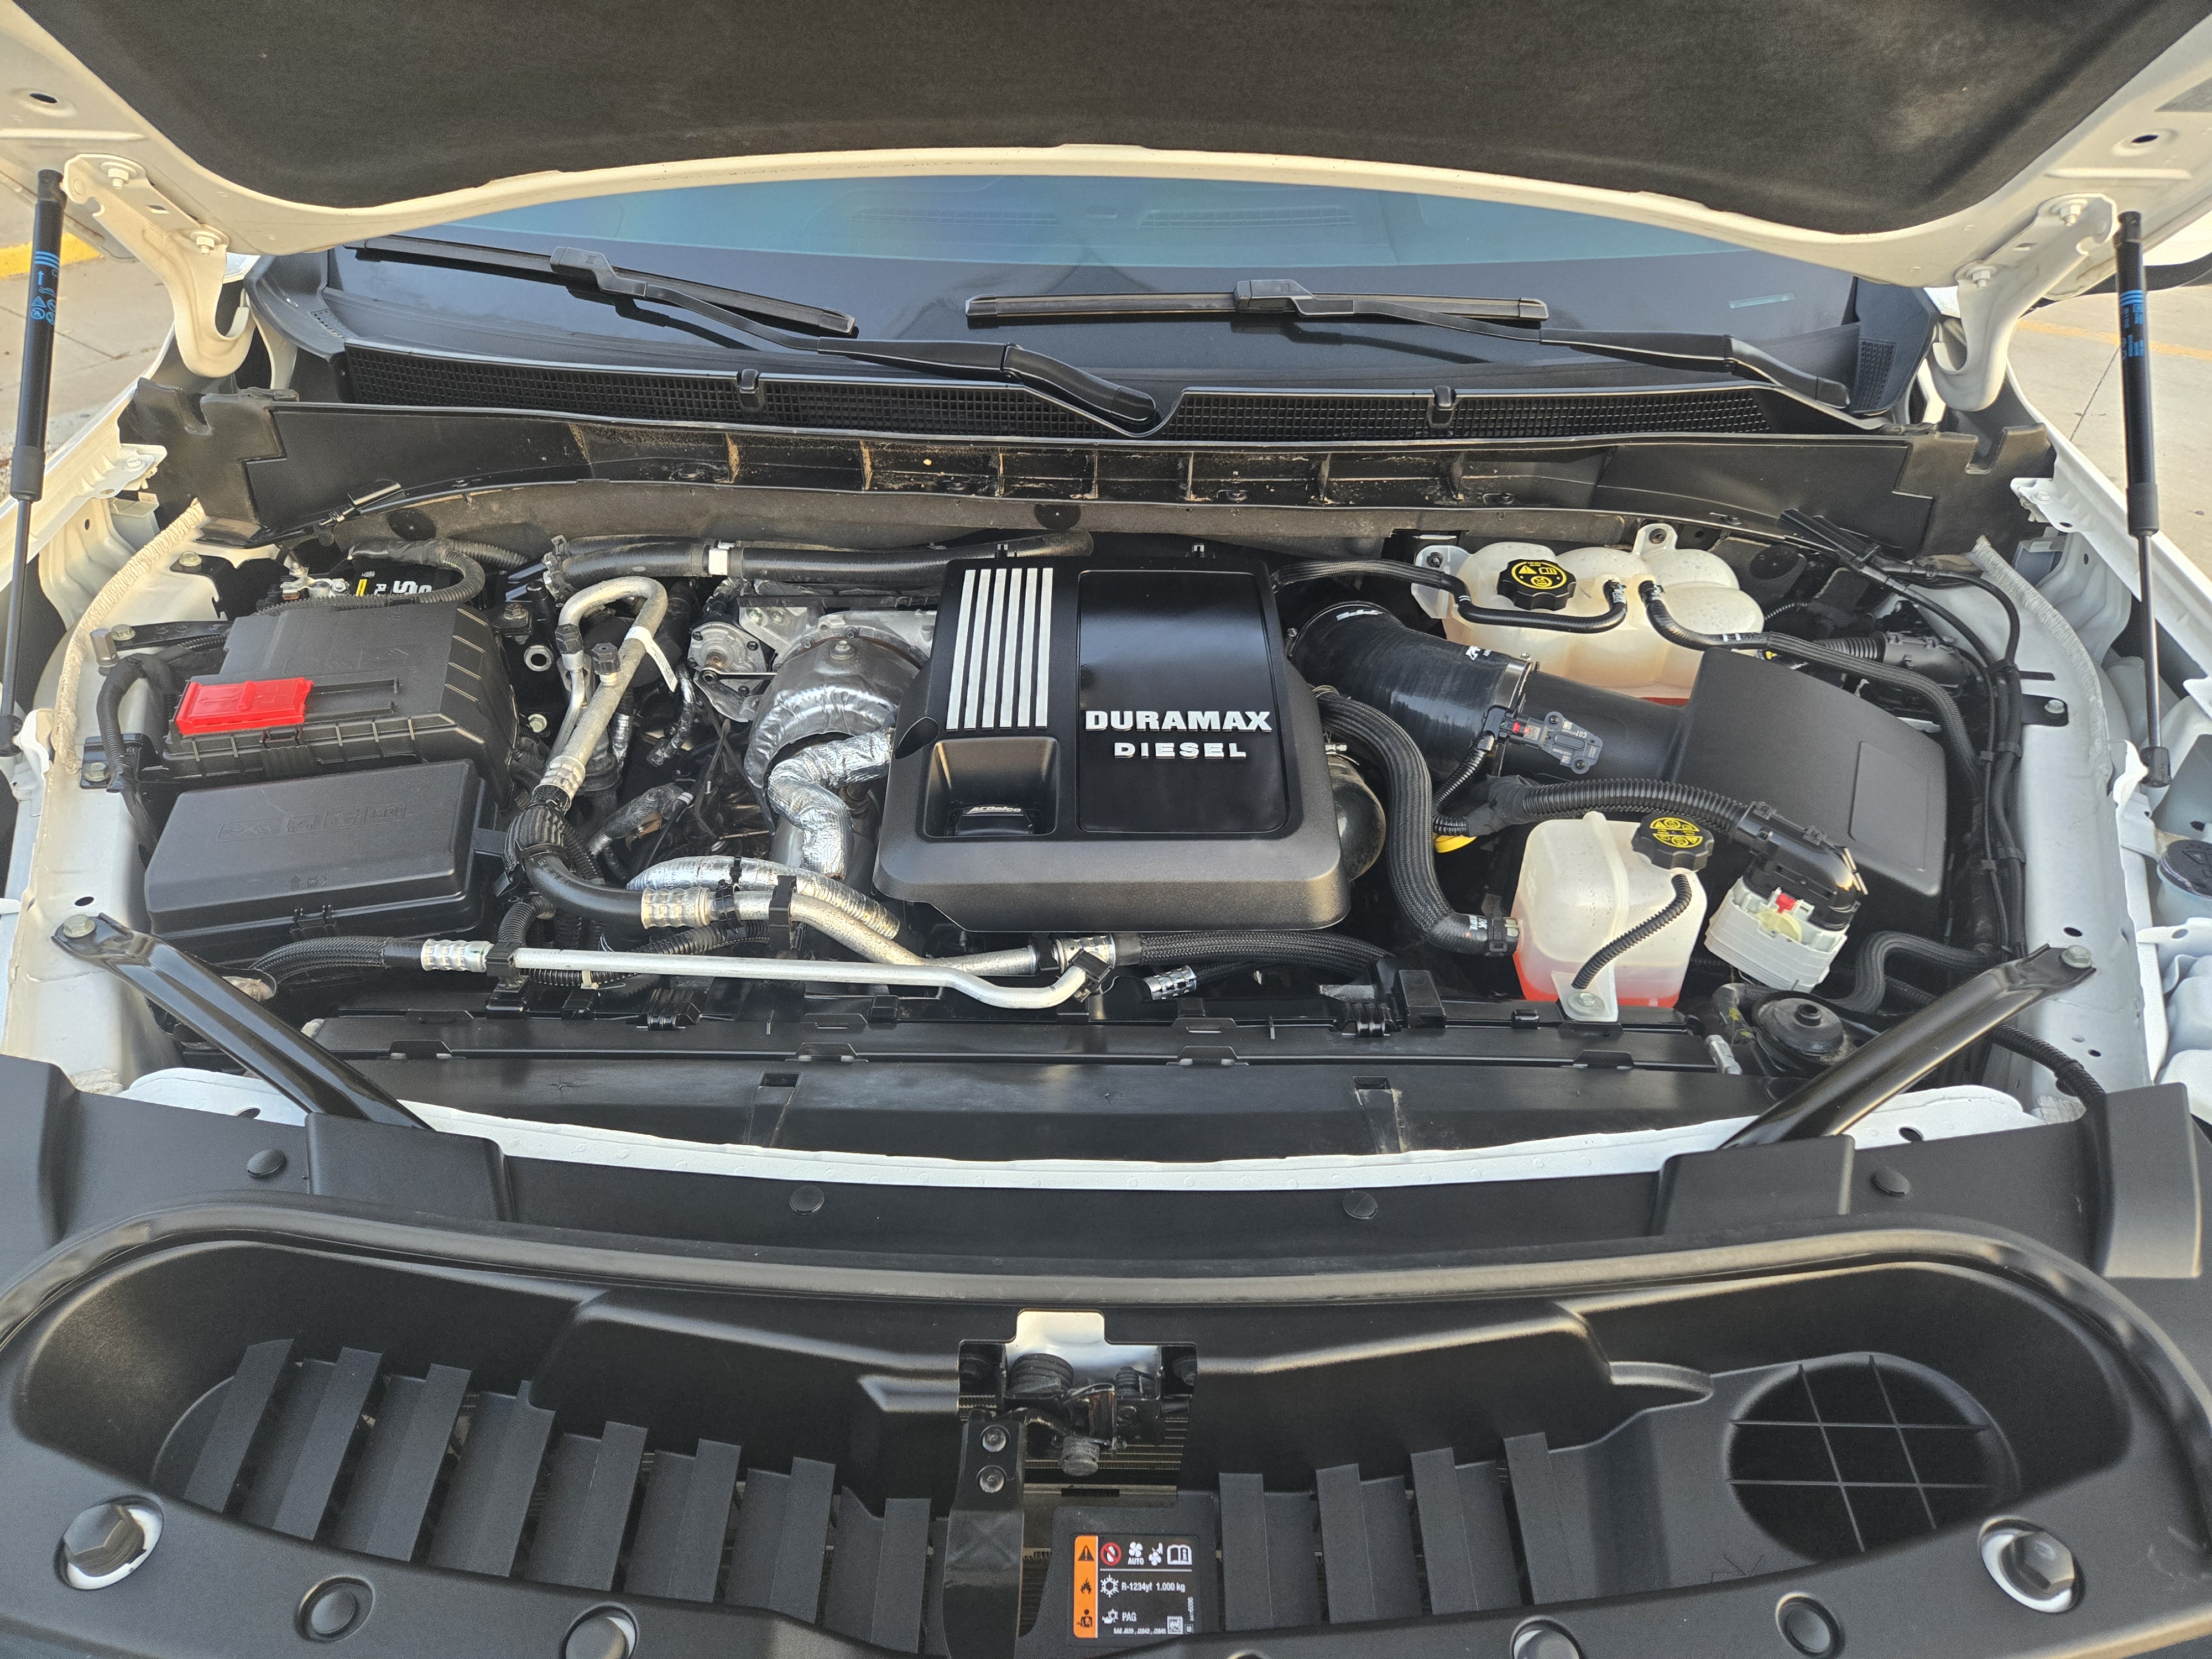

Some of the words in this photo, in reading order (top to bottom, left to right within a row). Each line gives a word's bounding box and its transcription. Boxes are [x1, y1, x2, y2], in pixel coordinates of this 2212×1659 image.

[1086, 711, 1272, 732] DURAMAX
[1114, 743, 1246, 758] DIESEL
[1121, 1582, 1152, 1593] R-1234yf
[1176, 1582, 1186, 1593] kg
[1121, 1611, 1137, 1622] PAG
